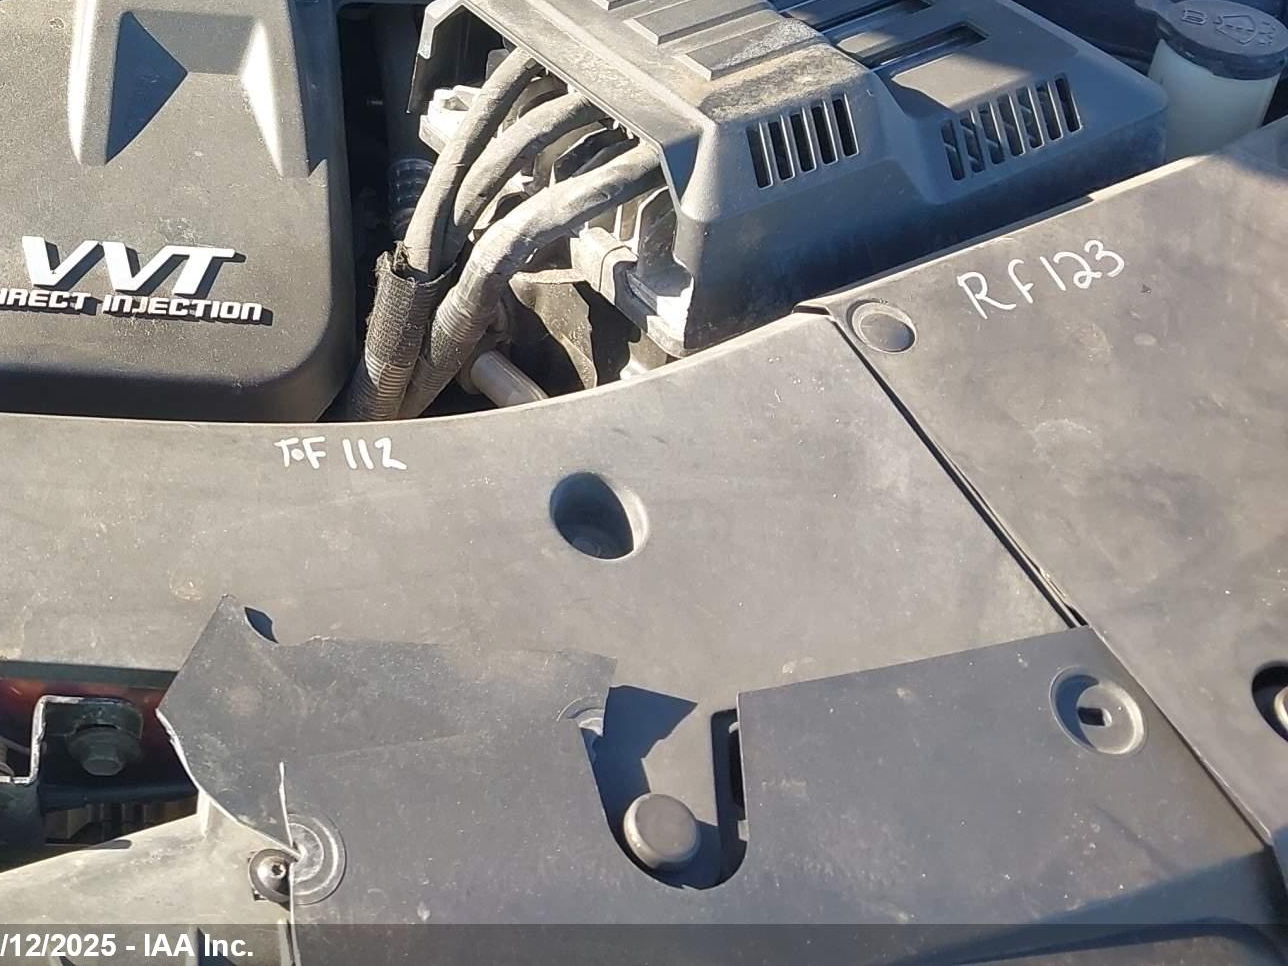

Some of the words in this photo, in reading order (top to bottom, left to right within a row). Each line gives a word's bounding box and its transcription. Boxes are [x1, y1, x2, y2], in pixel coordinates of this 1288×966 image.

[22, 235, 235, 296] VVT
[102, 294, 263, 322] INJECTION
[342, 437, 408, 470] 112
